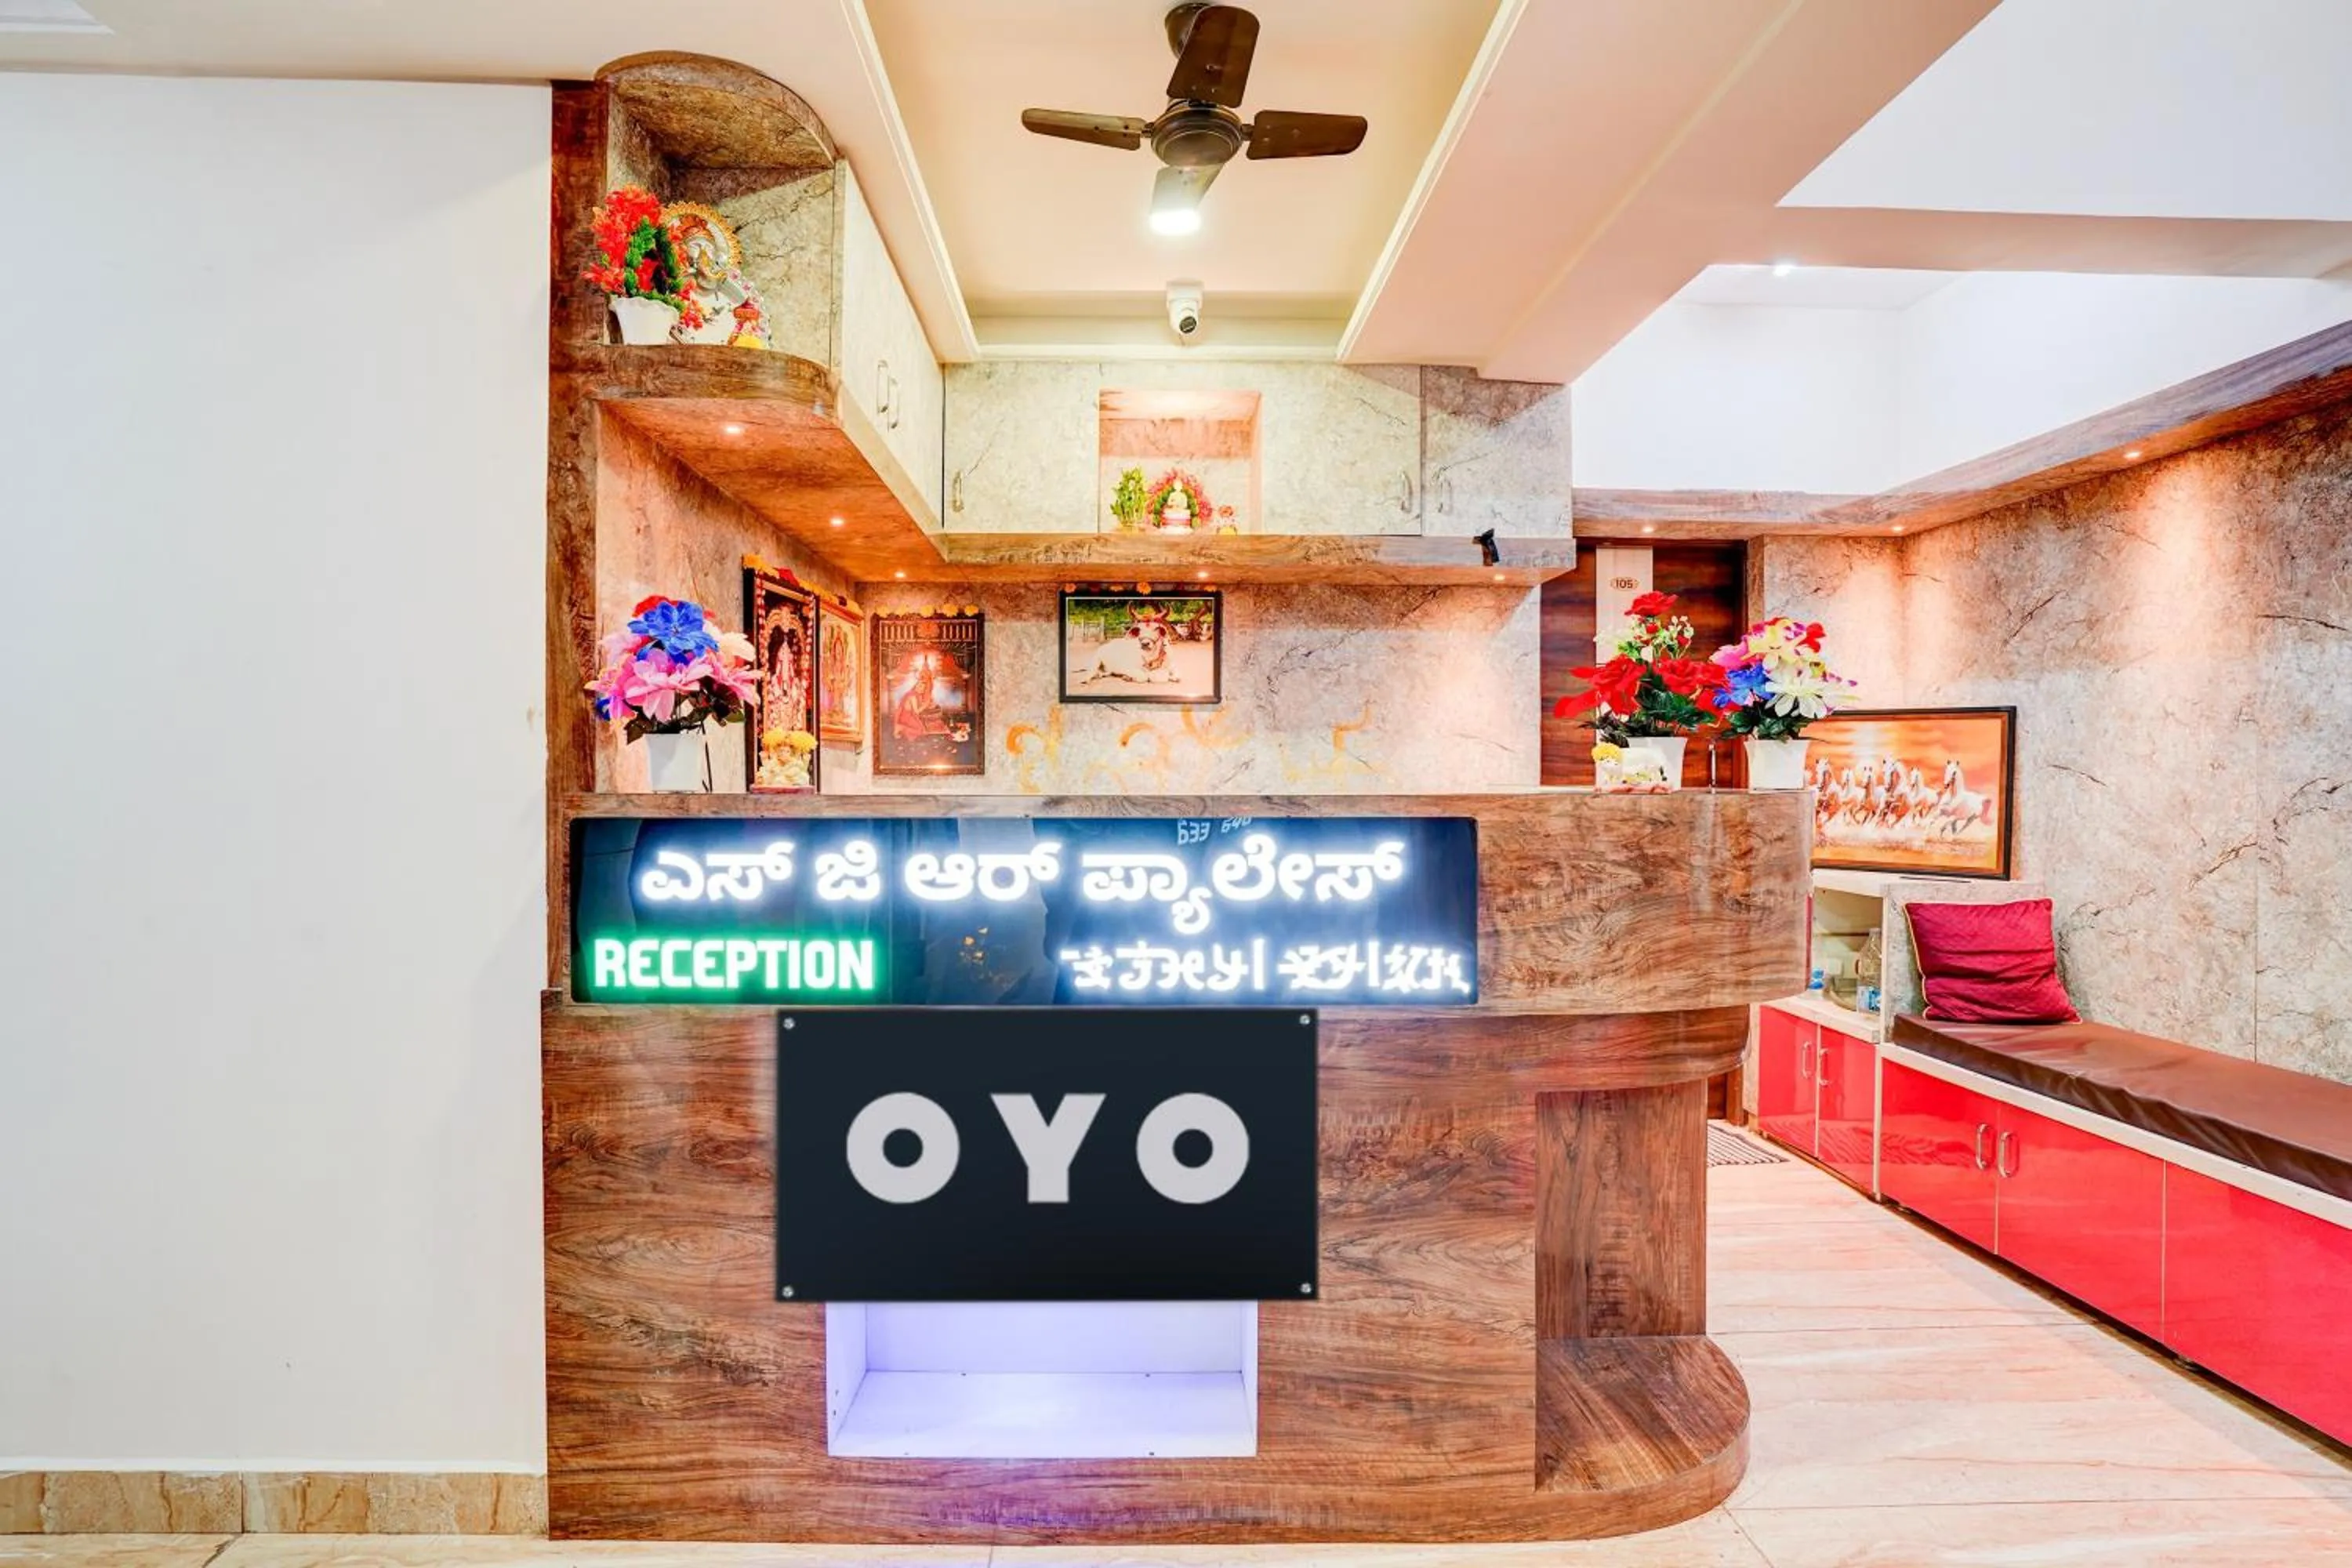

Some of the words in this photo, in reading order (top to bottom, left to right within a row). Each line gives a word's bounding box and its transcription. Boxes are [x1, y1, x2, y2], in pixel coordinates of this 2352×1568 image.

[1615, 579, 1633, 589] 105
[640, 840, 794, 902] ಎಸ್
[814, 839, 881, 902] ಜಿ
[903, 841, 1063, 902] ಆರ್
[593, 937, 876, 990] RECEPTION
[846, 1091, 1250, 1204] OYO
